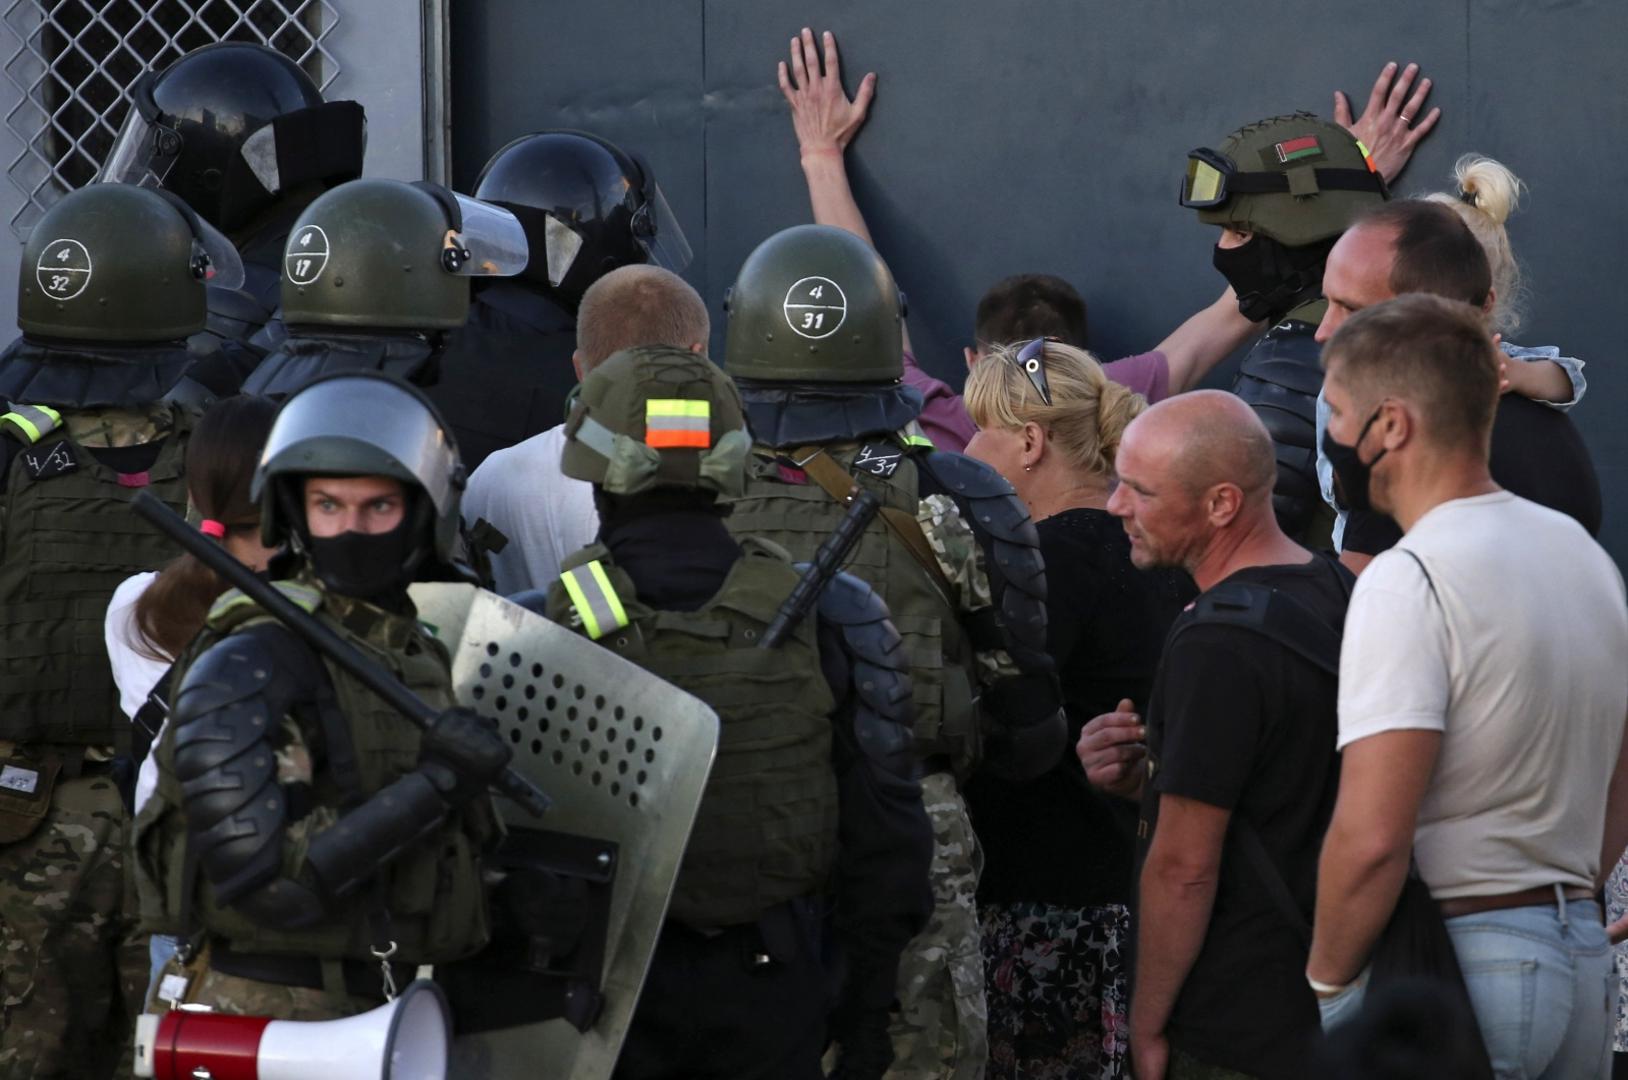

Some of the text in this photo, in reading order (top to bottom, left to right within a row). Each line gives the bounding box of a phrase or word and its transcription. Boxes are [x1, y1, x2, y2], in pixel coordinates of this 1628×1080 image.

[300, 232, 312, 247] 4
[56, 248, 70, 261] 4
[295, 259, 311, 276] 17
[49, 275, 70, 291] 32
[809, 285, 823, 299] 4
[801, 312, 824, 329] 31
